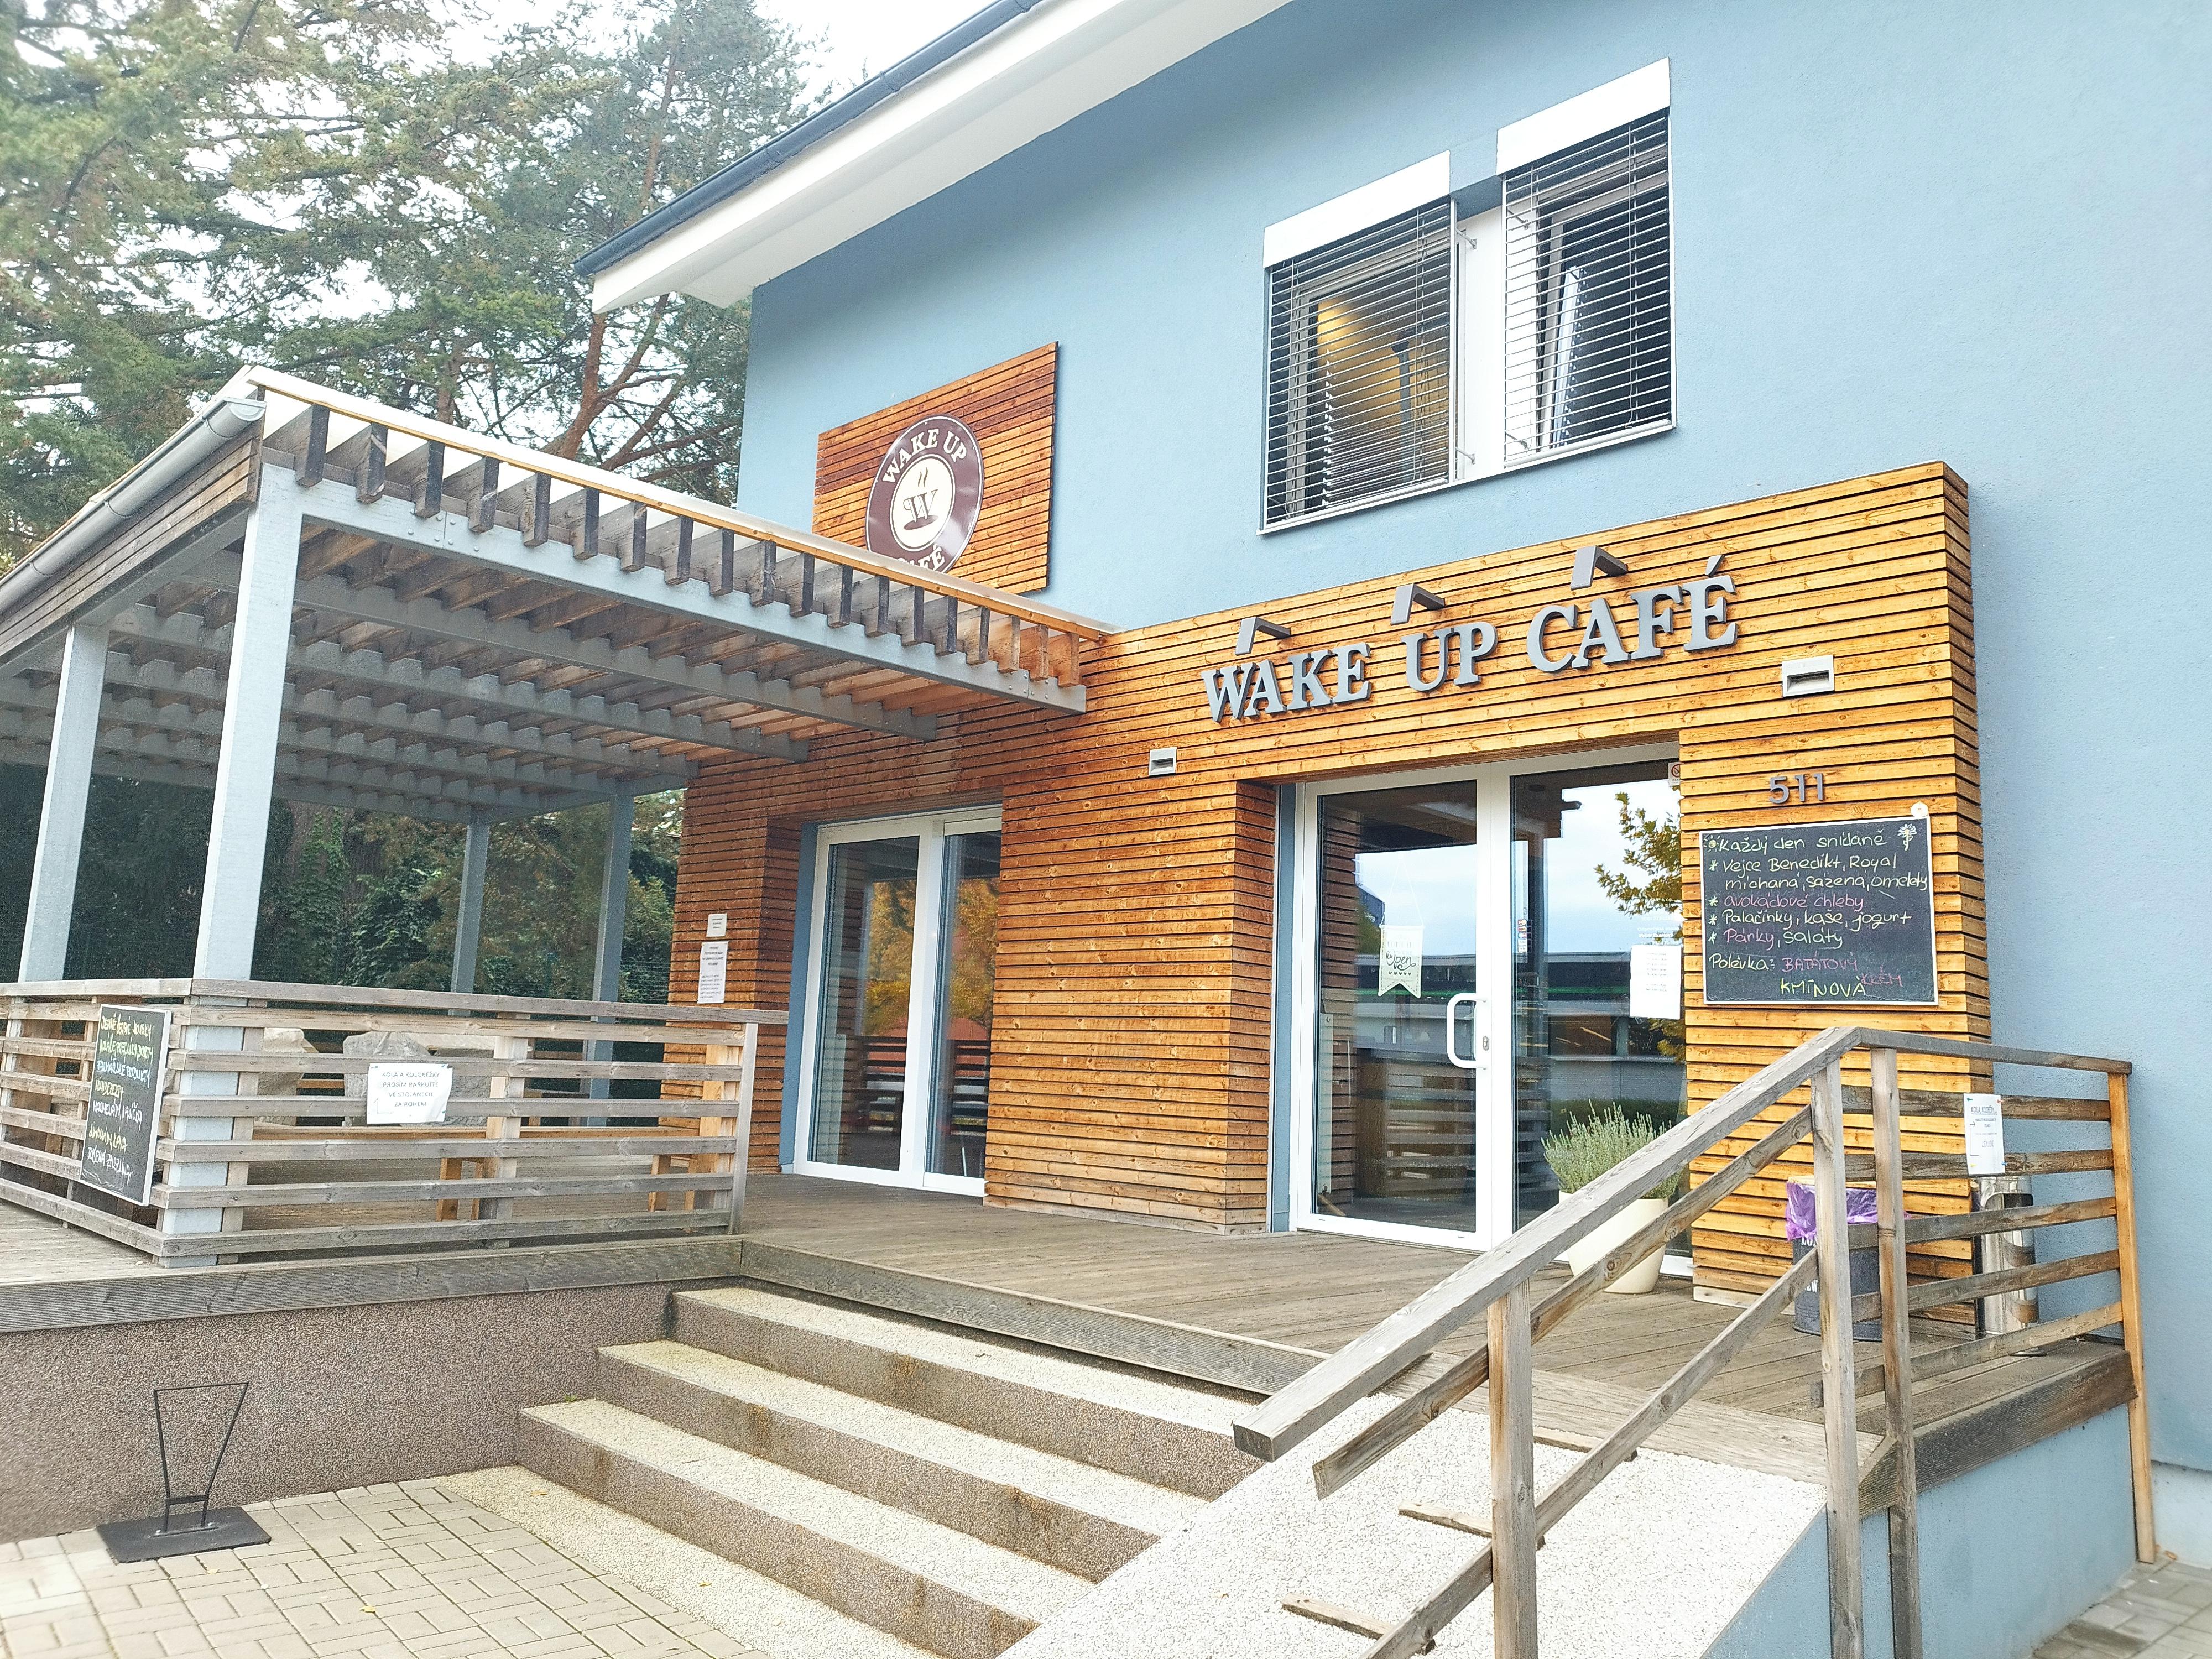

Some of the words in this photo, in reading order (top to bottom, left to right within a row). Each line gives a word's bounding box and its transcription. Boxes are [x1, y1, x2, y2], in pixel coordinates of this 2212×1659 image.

[881, 429, 940, 483] WAKE
[943, 430, 967, 463] UP
[1201, 641, 1372, 723] WAKE
[1400, 621, 1498, 692] UP
[1526, 554, 1739, 673] CAFÉ
[1769, 773, 1825, 804] 511
[1719, 835, 1768, 855] Každý
[1773, 837, 1806, 849] den
[1723, 859, 1762, 879] Vejce
[1849, 853, 1897, 873] Royal
[1871, 872, 1927, 891] omelety
[1724, 891, 1809, 909] avokádové
[1813, 893, 1864, 912] chleby
[1850, 911, 1912, 932] jogurt
[1783, 927, 1843, 950] saláty
[1385, 949, 1417, 971] Open
